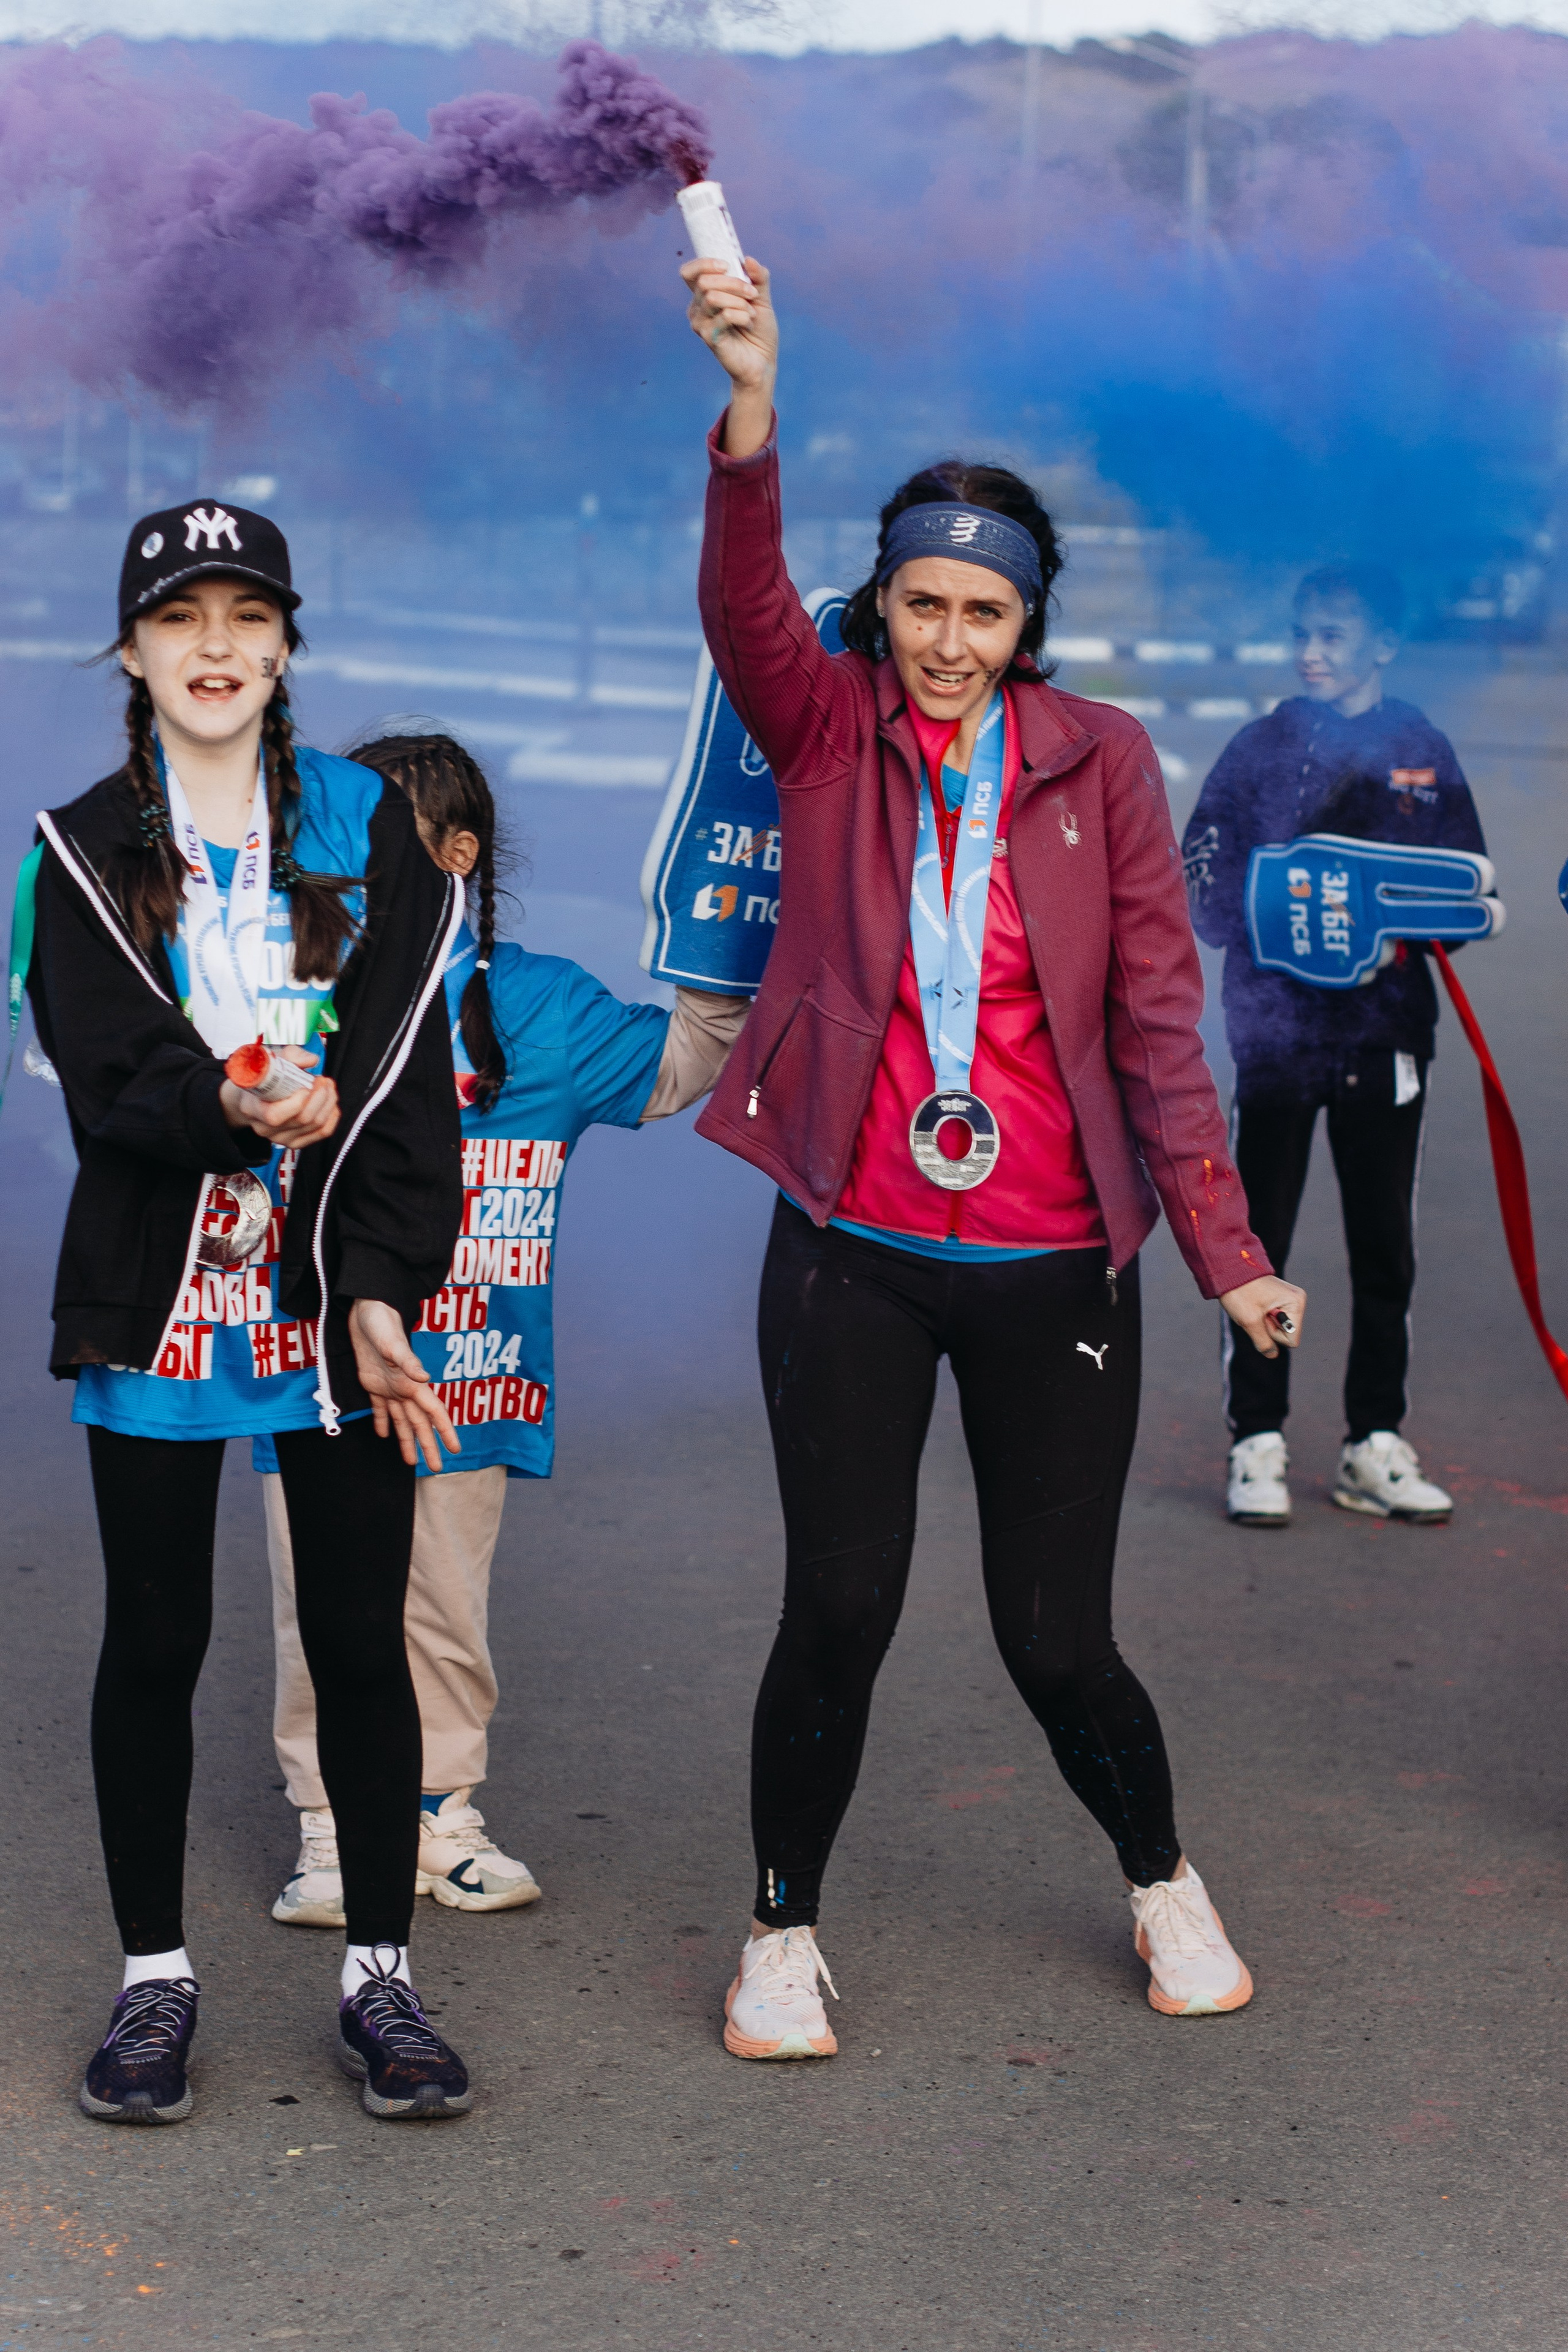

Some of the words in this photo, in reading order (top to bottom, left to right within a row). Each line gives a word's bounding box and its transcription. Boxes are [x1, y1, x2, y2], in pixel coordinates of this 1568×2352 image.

[972, 781, 993, 816] ПСБ
[744, 895, 782, 925] ПС
[462, 1139, 567, 1188] #ЦЕЛЬ
[445, 1237, 552, 1286] ОМЕНТ
[180, 1265, 272, 1326] БОВЬ
[442, 1329, 522, 1381] 2024
